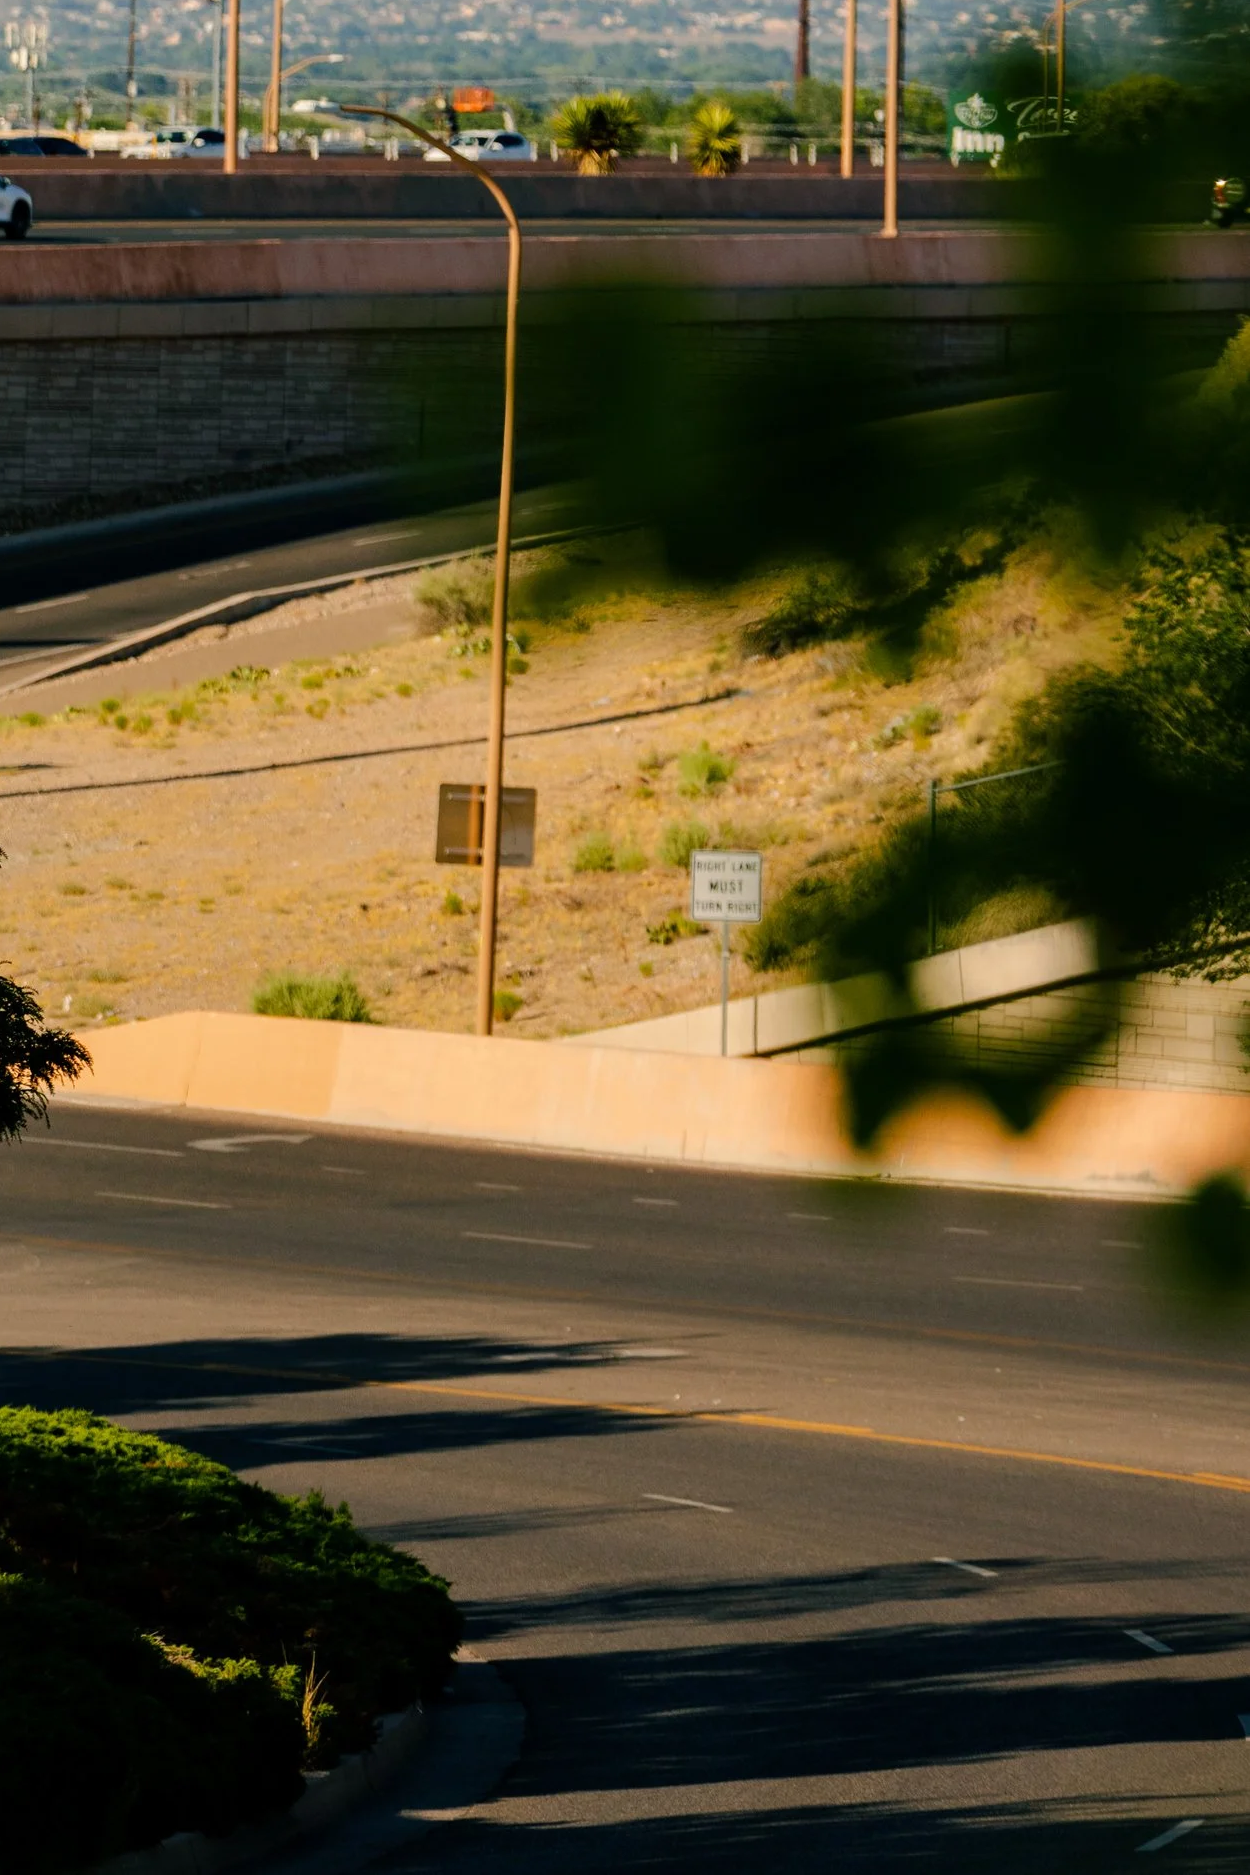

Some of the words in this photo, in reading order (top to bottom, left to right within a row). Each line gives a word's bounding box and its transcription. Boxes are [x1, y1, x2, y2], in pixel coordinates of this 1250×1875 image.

[952, 126, 1005, 154] Inn
[696, 861, 726, 873] RIGHT
[733, 861, 758, 873] LANE
[709, 878, 743, 894] MUST
[695, 899, 722, 912] TURN
[728, 900, 758, 914] RIGHT
